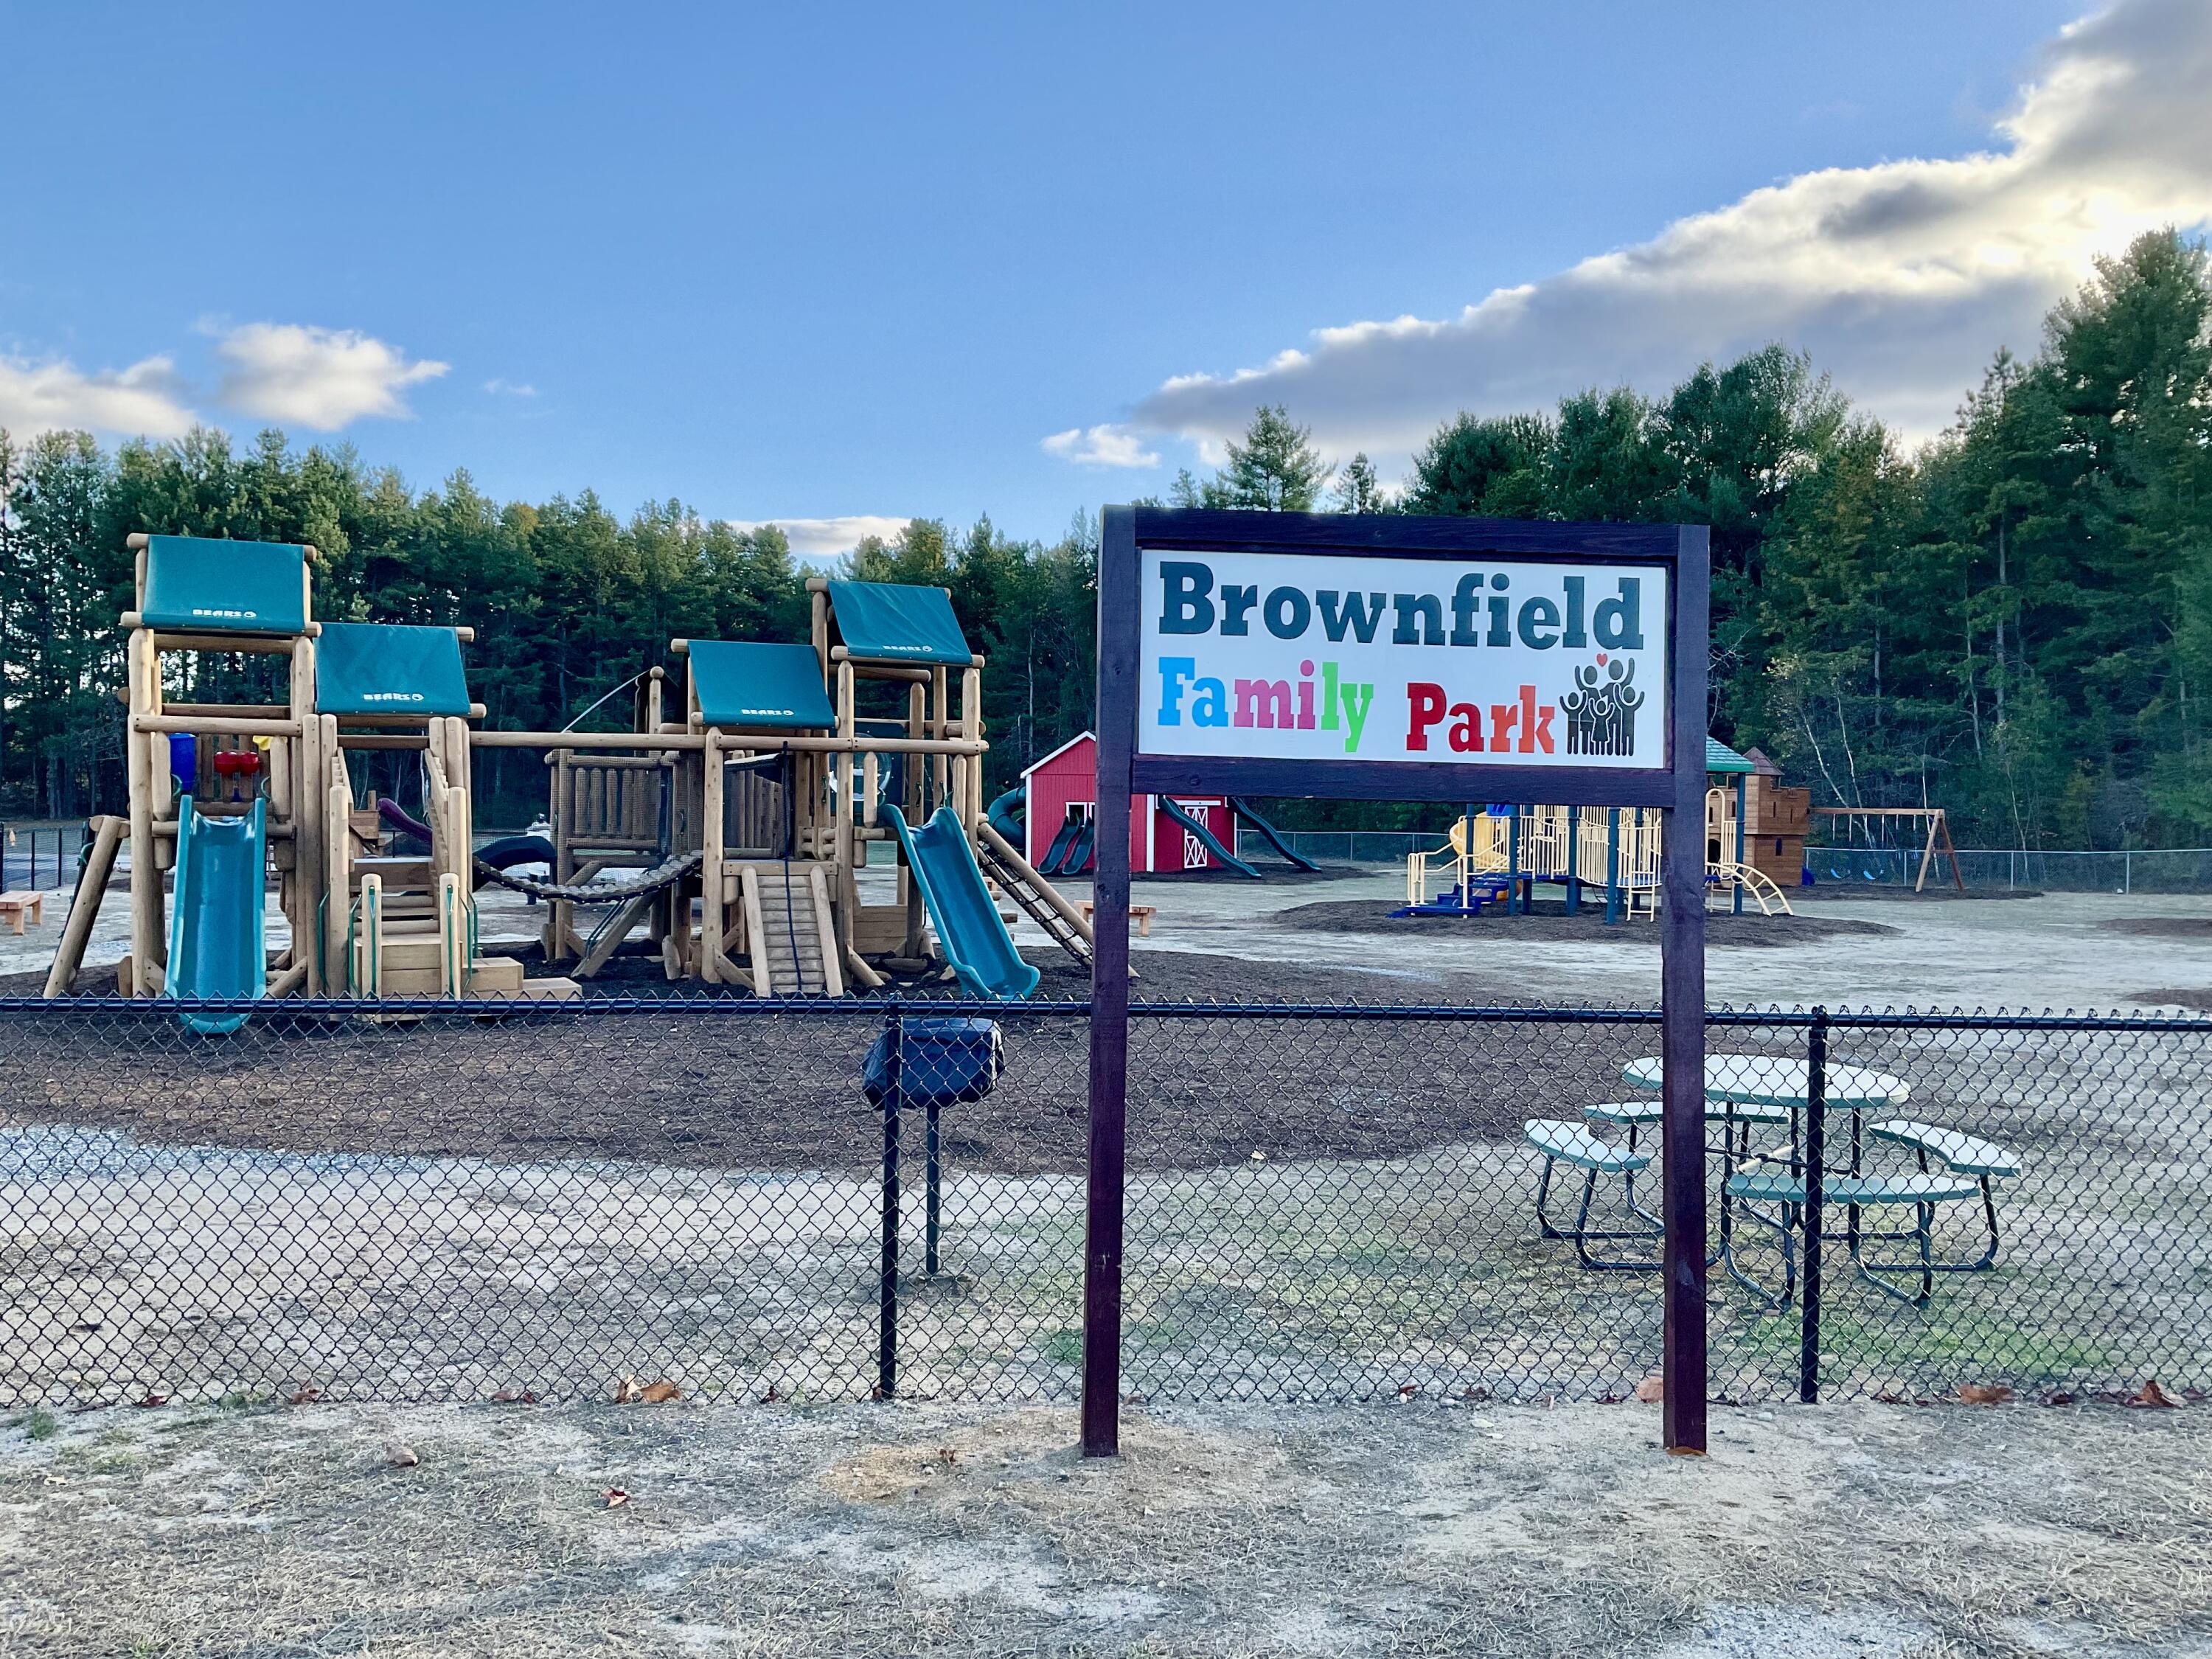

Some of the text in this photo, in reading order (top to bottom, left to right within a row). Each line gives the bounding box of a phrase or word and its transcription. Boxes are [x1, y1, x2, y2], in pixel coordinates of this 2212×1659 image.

[192, 609, 242, 618] BEARS
[1158, 561, 1644, 650] Brownfield
[364, 692, 411, 701] BEARS
[1158, 657, 1555, 754] Family Park
